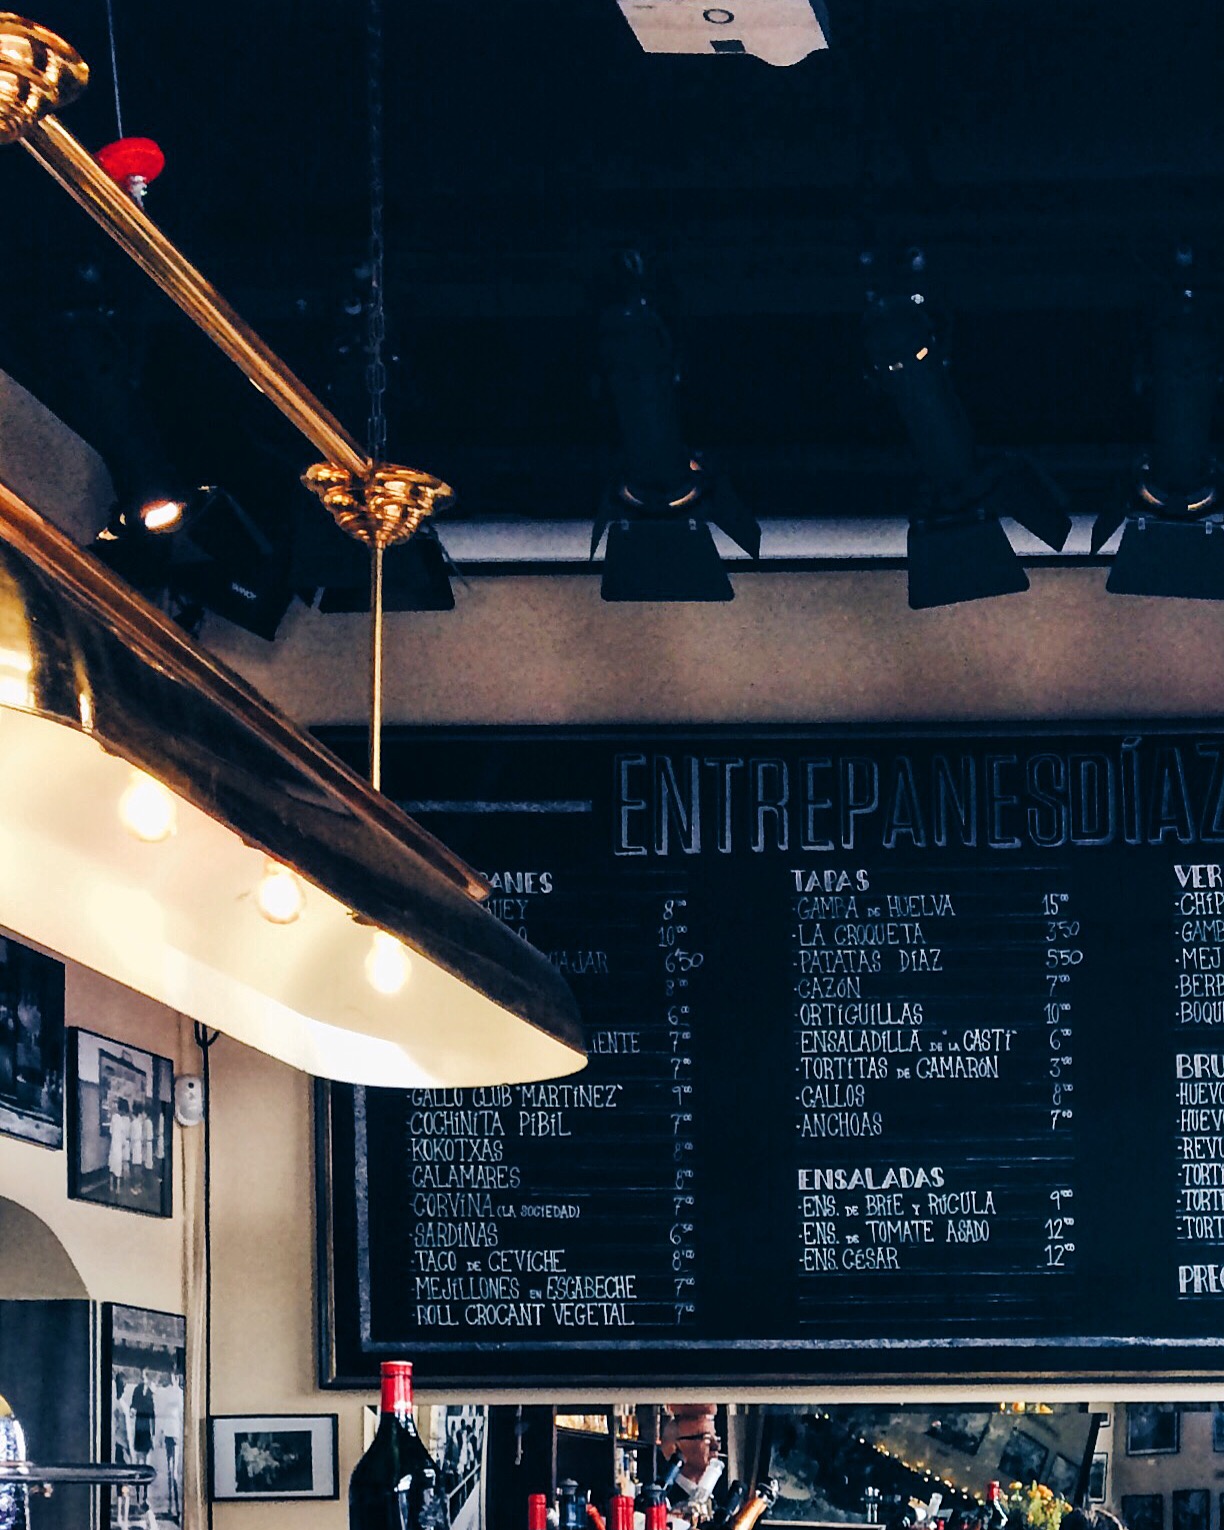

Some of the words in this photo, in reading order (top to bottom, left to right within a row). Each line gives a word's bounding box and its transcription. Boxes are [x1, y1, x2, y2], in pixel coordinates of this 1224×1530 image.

[791, 869, 869, 892] TAPAS
[798, 896, 858, 920] GAMBA
[868, 907, 880, 917] DE
[888, 894, 955, 916] HUELVA
[799, 923, 825, 946] LA
[835, 923, 926, 945] CROQUETA
[800, 950, 881, 973] PATATAS
[801, 1029, 922, 1053] ENSALADILLA
[801, 1056, 888, 1080] TORTITAS
[896, 1067, 910, 1079] DE
[412, 1088, 463, 1107] GALLO
[472, 1086, 512, 1107] CLUB
[801, 1084, 865, 1108] CALLOS
[802, 1112, 883, 1137] ANCHOAS
[412, 1139, 503, 1162] KOKOTXAS
[412, 1165, 520, 1189] CALAMARES
[799, 1167, 945, 1190] ENSALADAS
[413, 1193, 493, 1218] CORVINA
[414, 1222, 498, 1247] SARDINAS
[866, 1220, 934, 1243] TOMATE
[946, 1220, 989, 1242] ASADO
[415, 1250, 457, 1272] TACO
[489, 1249, 566, 1272] CEVICHE
[843, 1247, 900, 1270] CÉSAR
[416, 1277, 519, 1300] MEJILLONES
[547, 1275, 637, 1300] ESCABECHE
[417, 1304, 459, 1326] ROLL
[465, 1303, 545, 1326] CROCANT
[552, 1303, 634, 1326] VEGETAL
